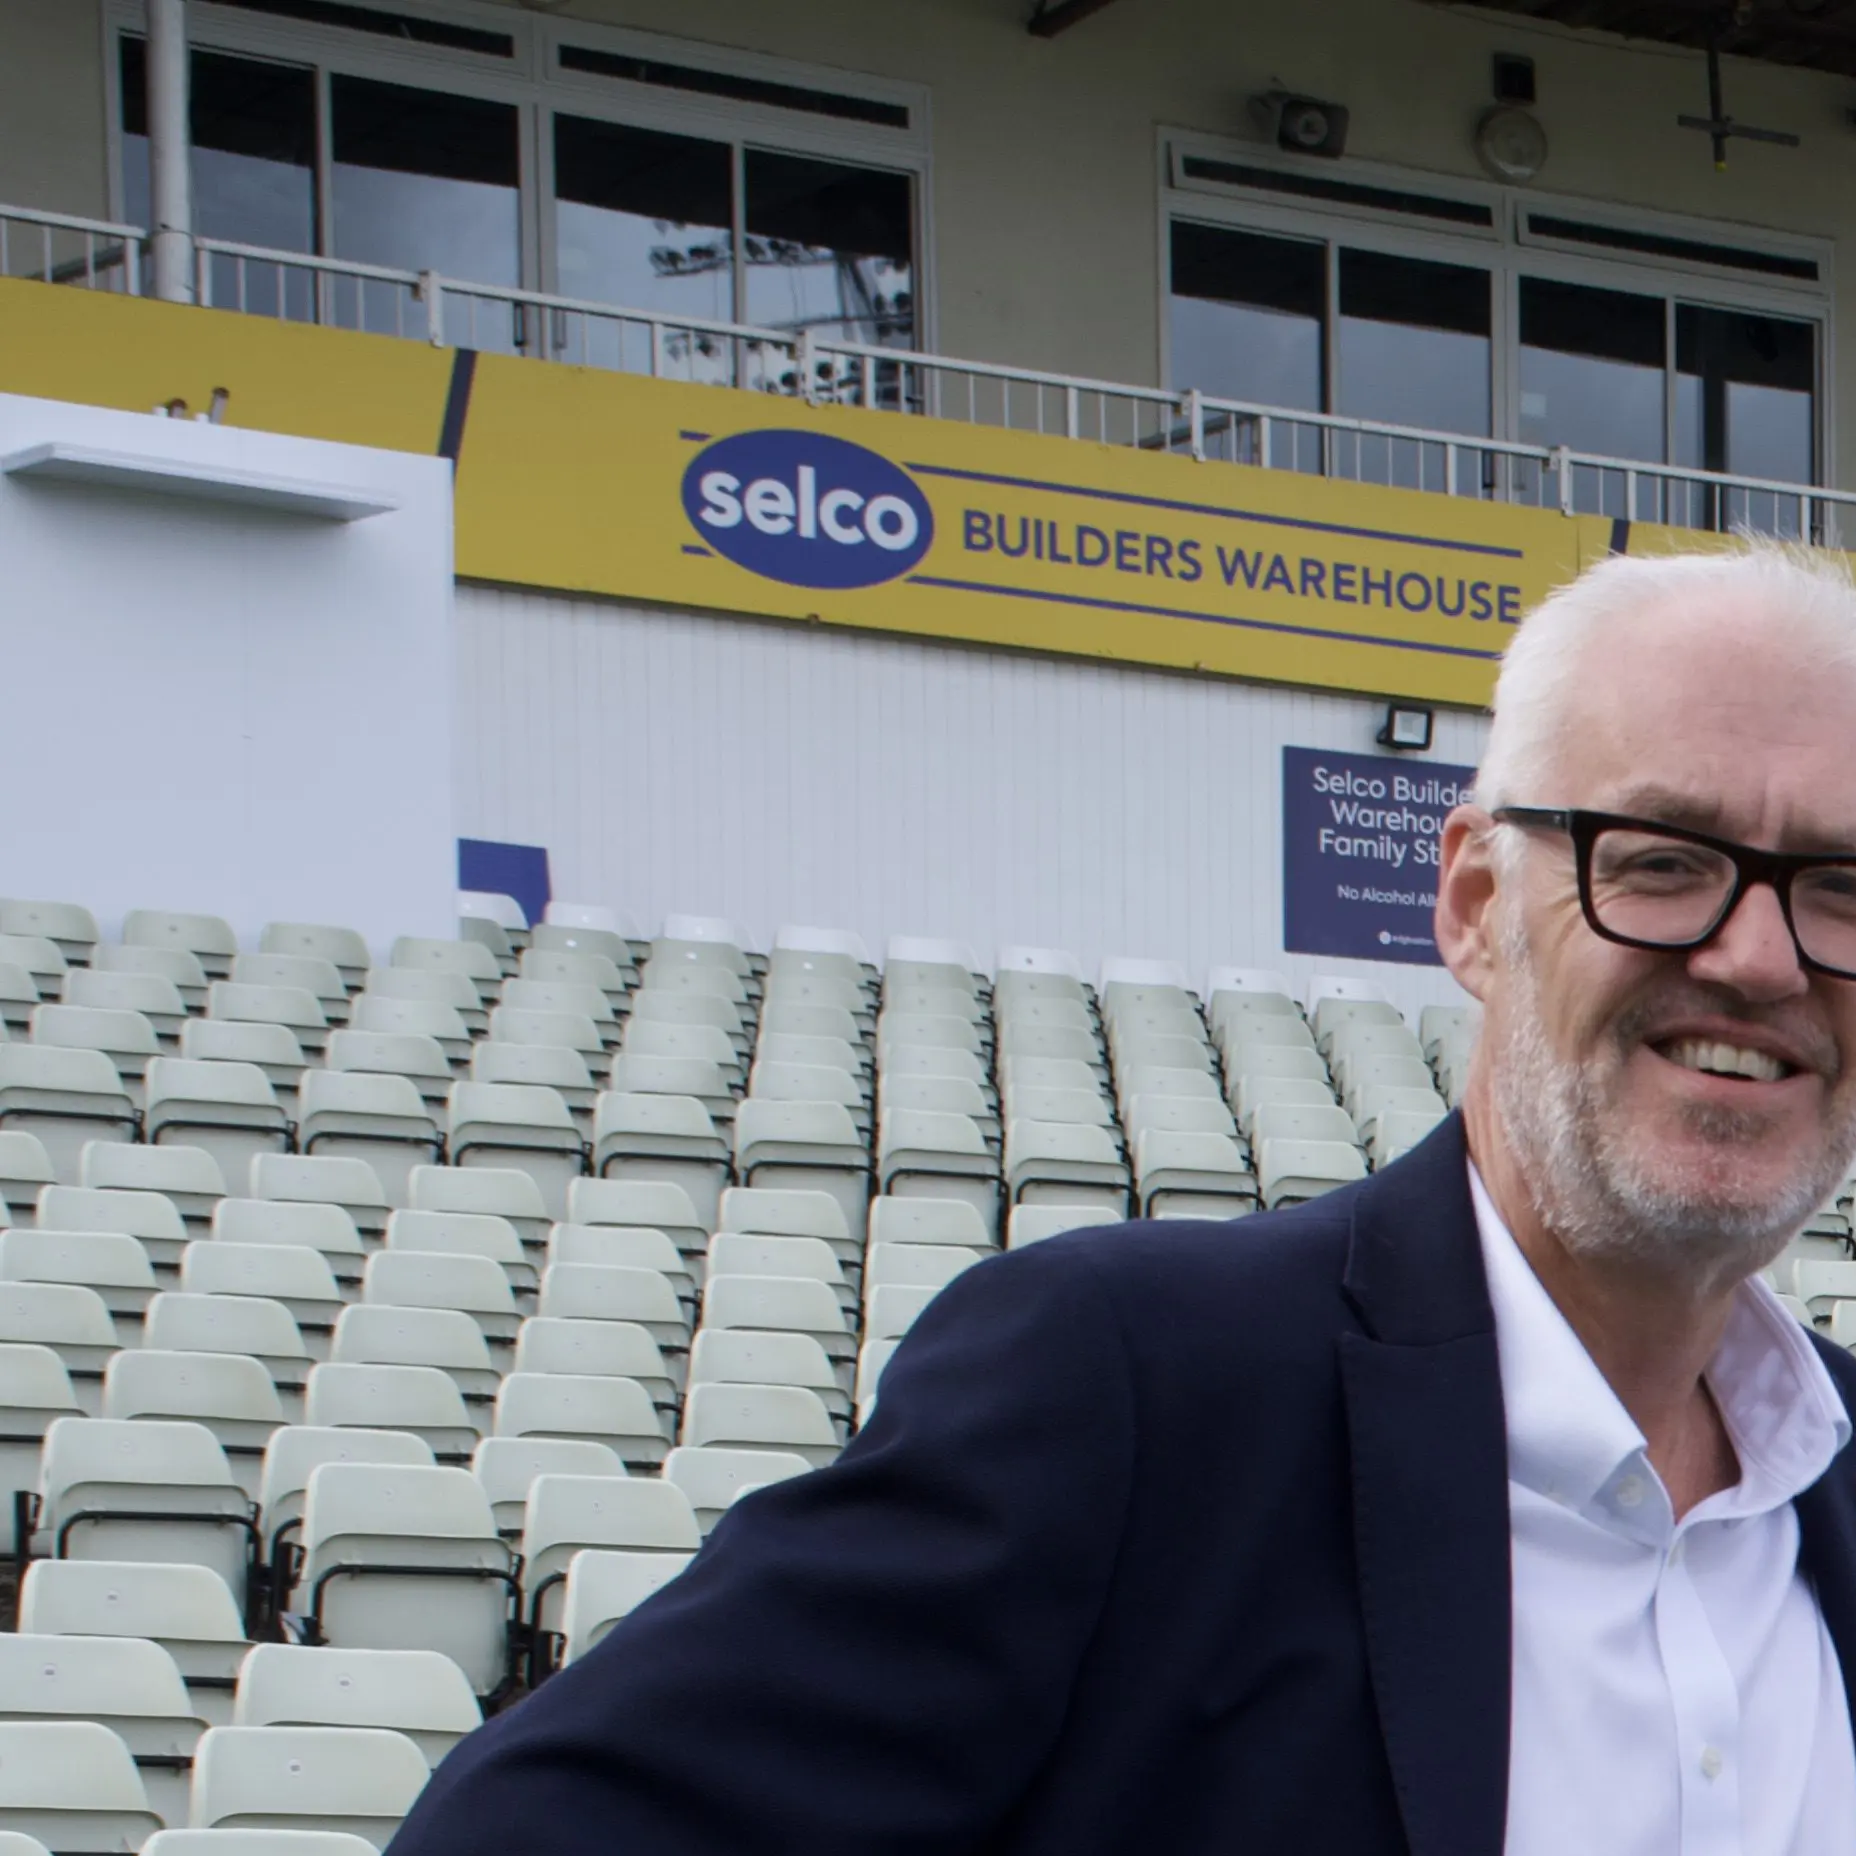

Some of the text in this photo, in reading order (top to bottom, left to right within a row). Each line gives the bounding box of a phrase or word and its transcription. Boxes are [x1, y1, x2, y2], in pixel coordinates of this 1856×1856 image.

[699, 465, 1522, 625] selco BUILDERS WAREHOUSE
[1313, 766, 1476, 807] Selco Builde
[1329, 799, 1444, 835] Warehou
[1319, 828, 1407, 868] Family
[1337, 884, 1359, 901] No
[1361, 887, 1416, 906] Alcohol
